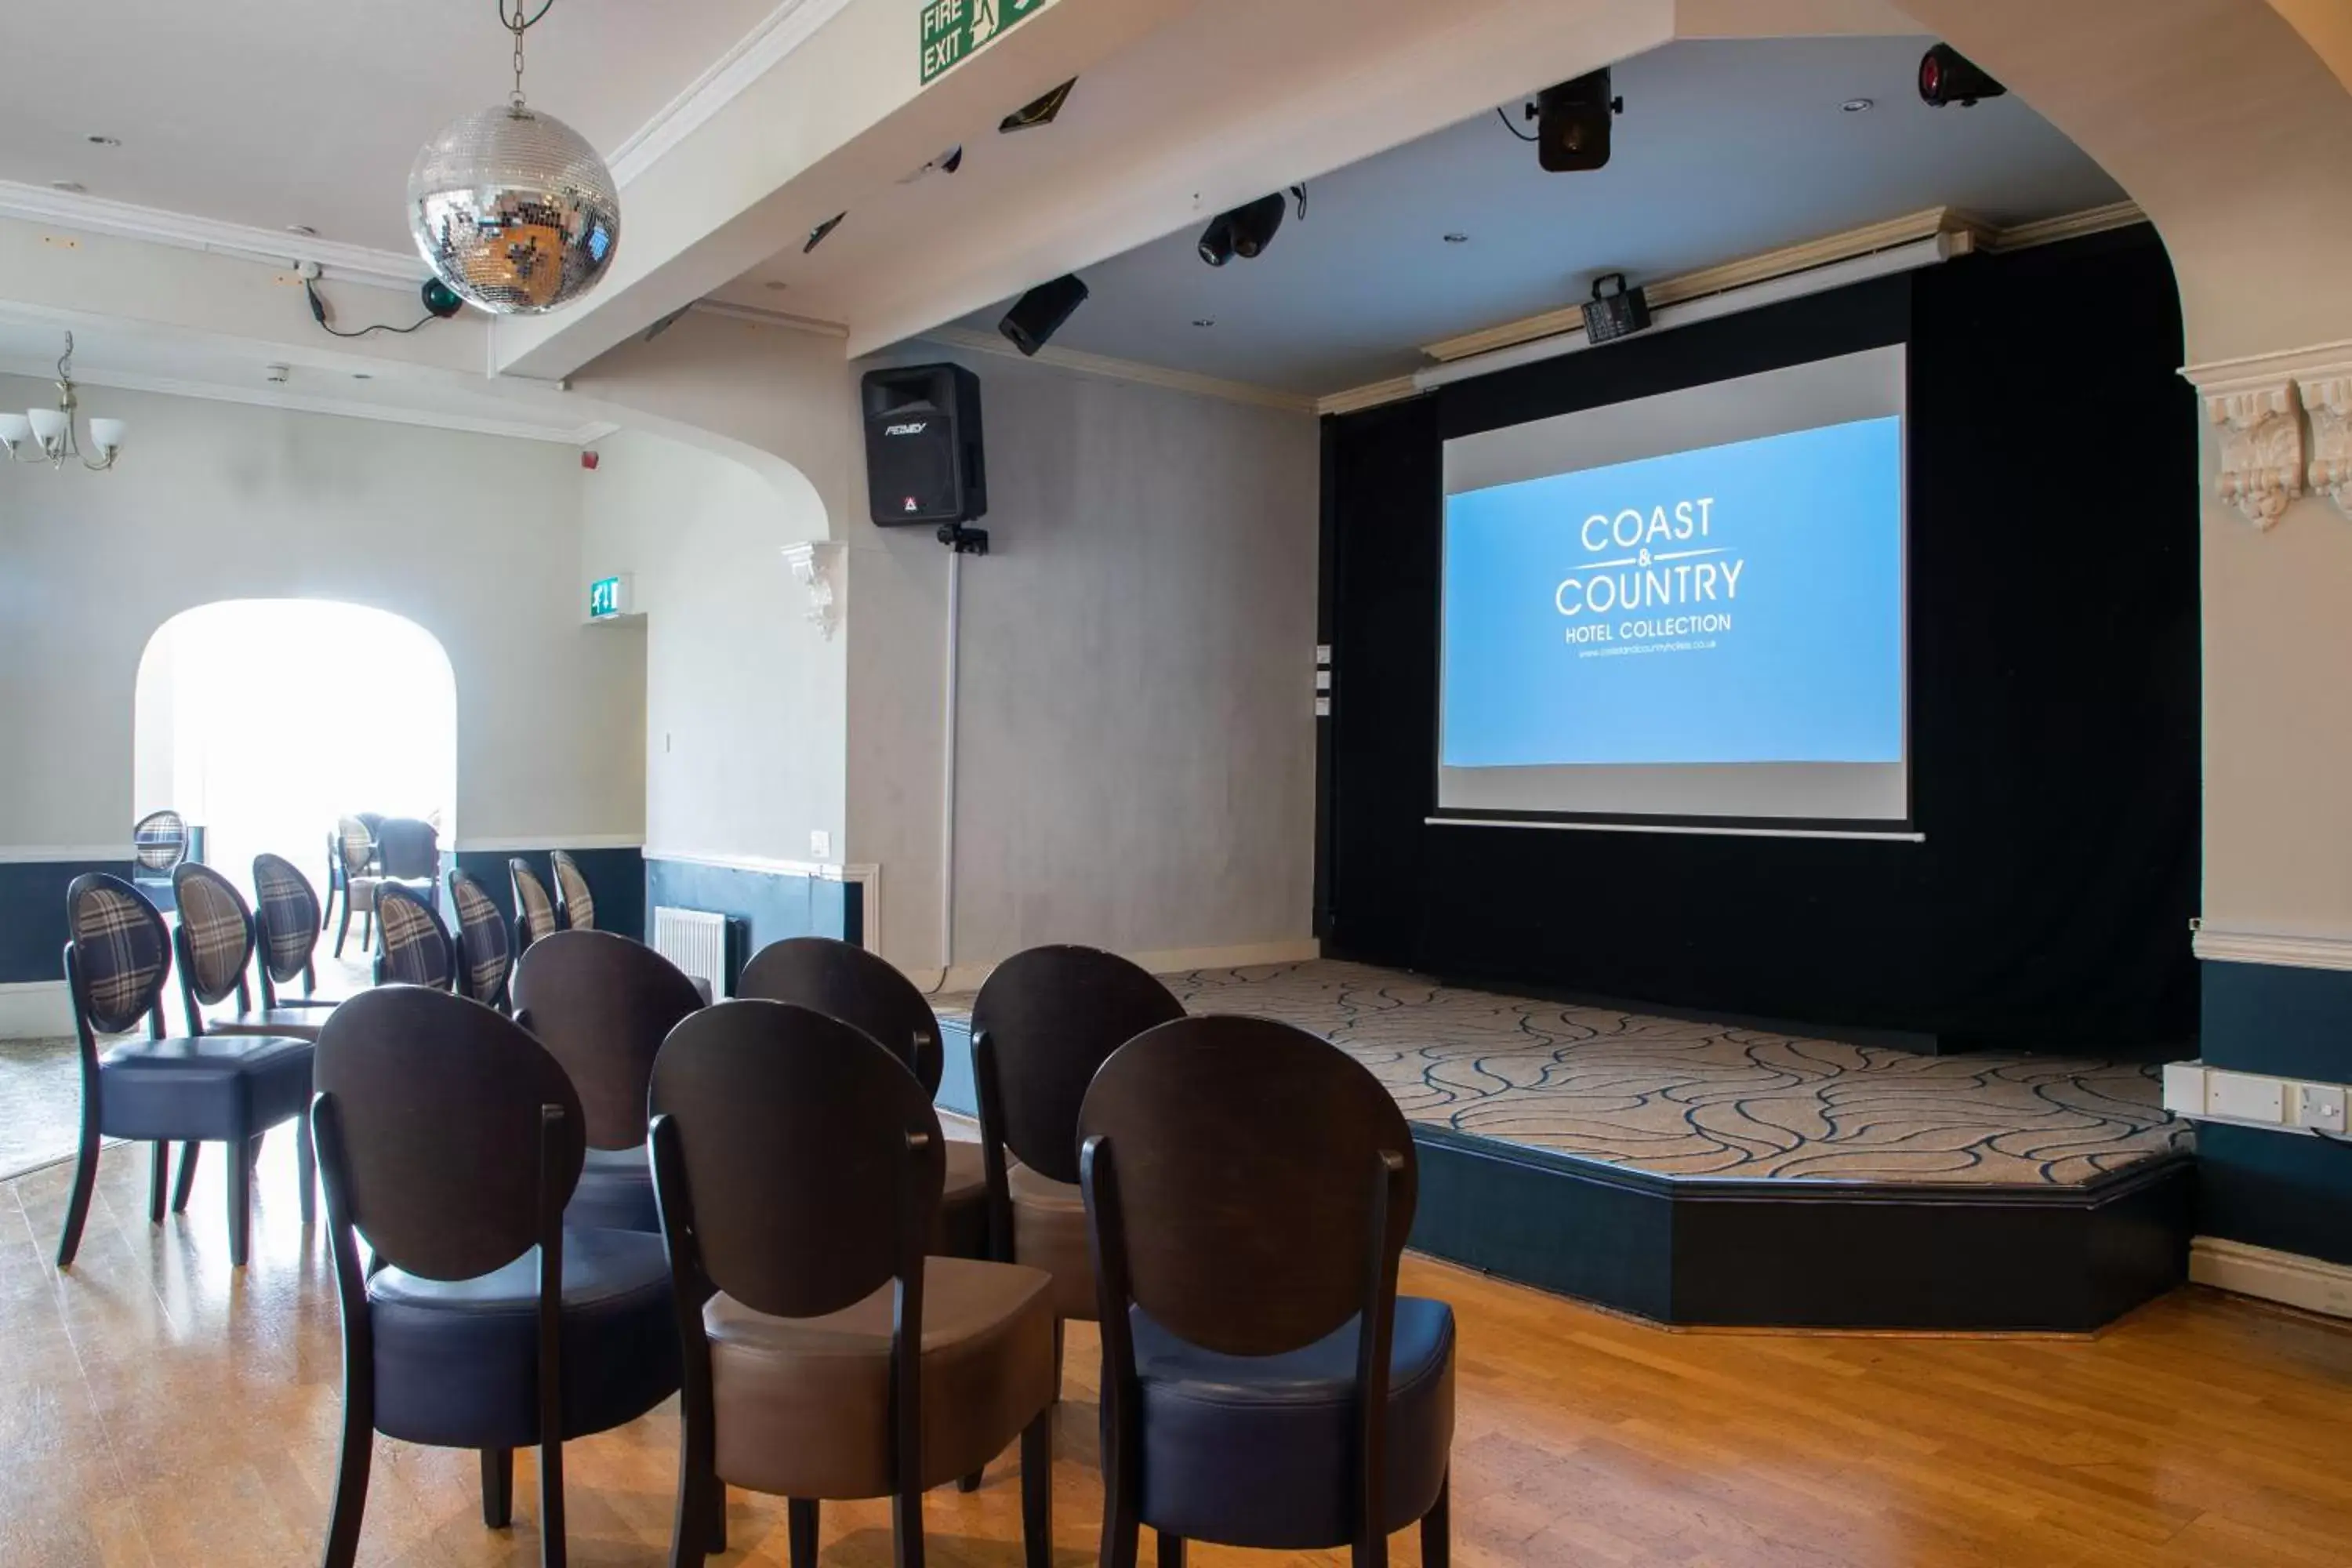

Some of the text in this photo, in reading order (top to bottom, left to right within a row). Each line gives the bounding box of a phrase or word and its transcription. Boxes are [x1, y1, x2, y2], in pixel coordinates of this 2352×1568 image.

[924, 0, 963, 40] FIRE
[924, 27, 963, 78] EXIT
[1581, 497, 1714, 552] COAST
[1639, 546, 1652, 567] &
[1555, 558, 1744, 616] COUNTRY
[1565, 614, 1731, 644] HOTEL COLLECTION
